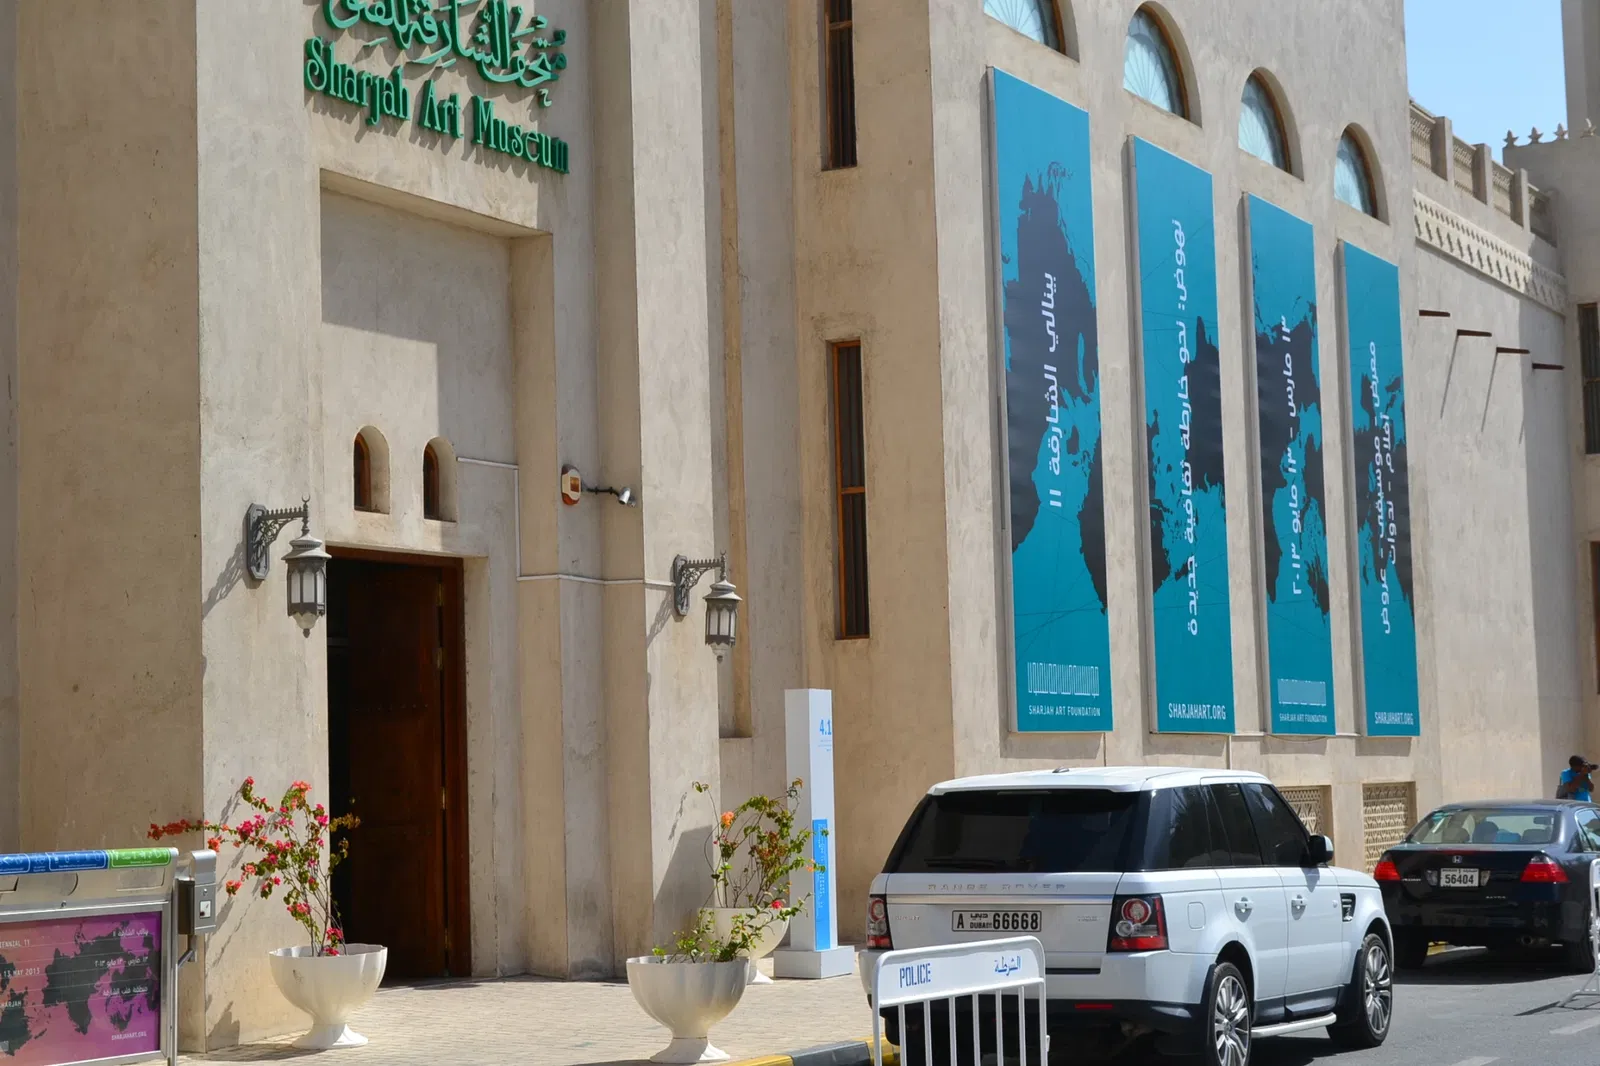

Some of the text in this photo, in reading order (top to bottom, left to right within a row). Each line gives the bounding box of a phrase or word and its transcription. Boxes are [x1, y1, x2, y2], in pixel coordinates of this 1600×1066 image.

[304, 36, 570, 174] Sharjah Art Museum
[1042, 272, 1058, 352] بينالي
[1176, 320, 1190, 364] نحو
[1177, 375, 1192, 450] خارطة
[1283, 352, 1296, 418] مارس
[1044, 364, 1063, 476] الشارقة
[1179, 460, 1194, 544] ثقافية
[1288, 484, 1302, 536] مايو
[1369, 340, 1380, 408] معرض
[1380, 568, 1391, 634] عروض
[1187, 555, 1198, 636] جديدة
[1029, 705, 1101, 717] SHARJAH ART FOUNDATION
[1168, 702, 1226, 720] SHARJAHART.ORG
[1444, 874, 1474, 884] 56404
[957, 912, 1038, 930] A 66668
[900, 962, 932, 988] POLICE
[994, 956, 1021, 976] الشرطة
